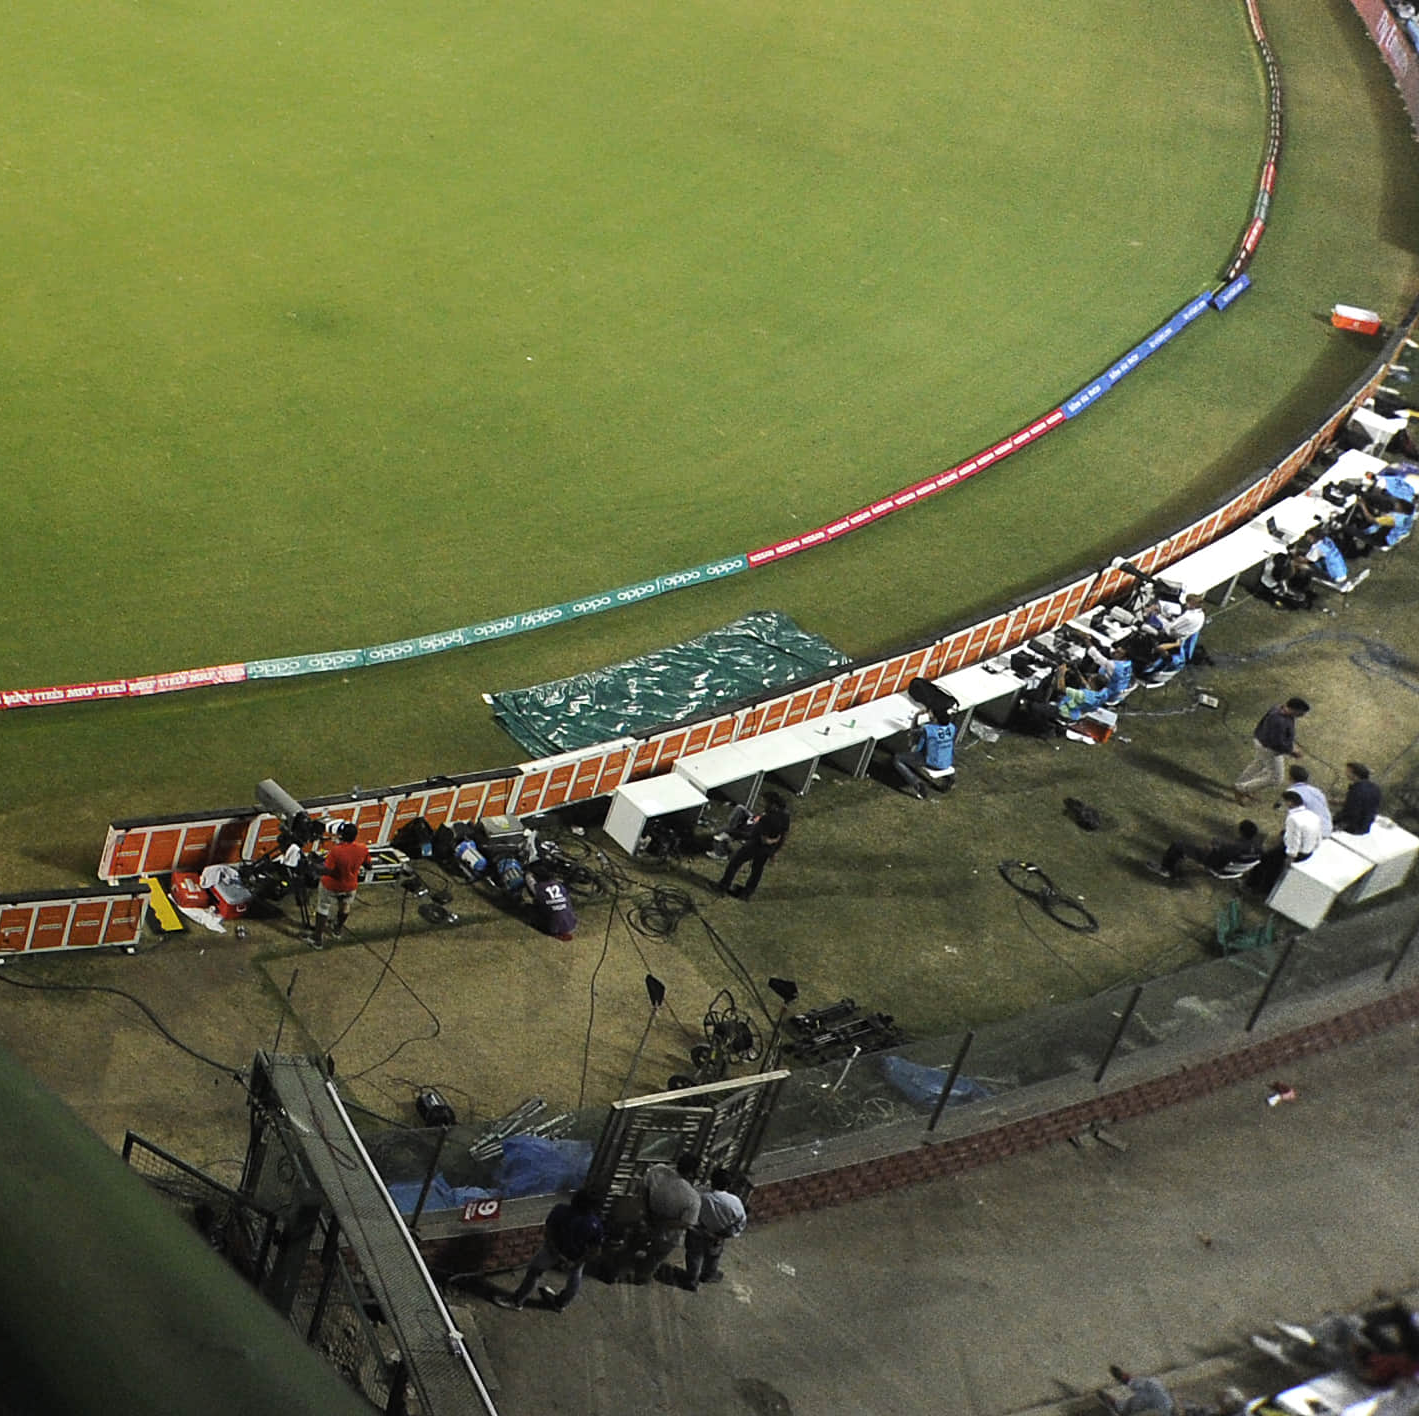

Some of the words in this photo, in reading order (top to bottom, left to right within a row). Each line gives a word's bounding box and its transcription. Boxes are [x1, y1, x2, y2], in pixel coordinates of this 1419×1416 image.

[706, 559, 743, 576] oppo
[664, 569, 701, 587] oppo
[617, 583, 655, 602] oppo
[572, 596, 611, 613] oppo
[369, 644, 413, 660] oppo
[309, 653, 357, 670] oppo
[545, 885, 563, 899] 12
